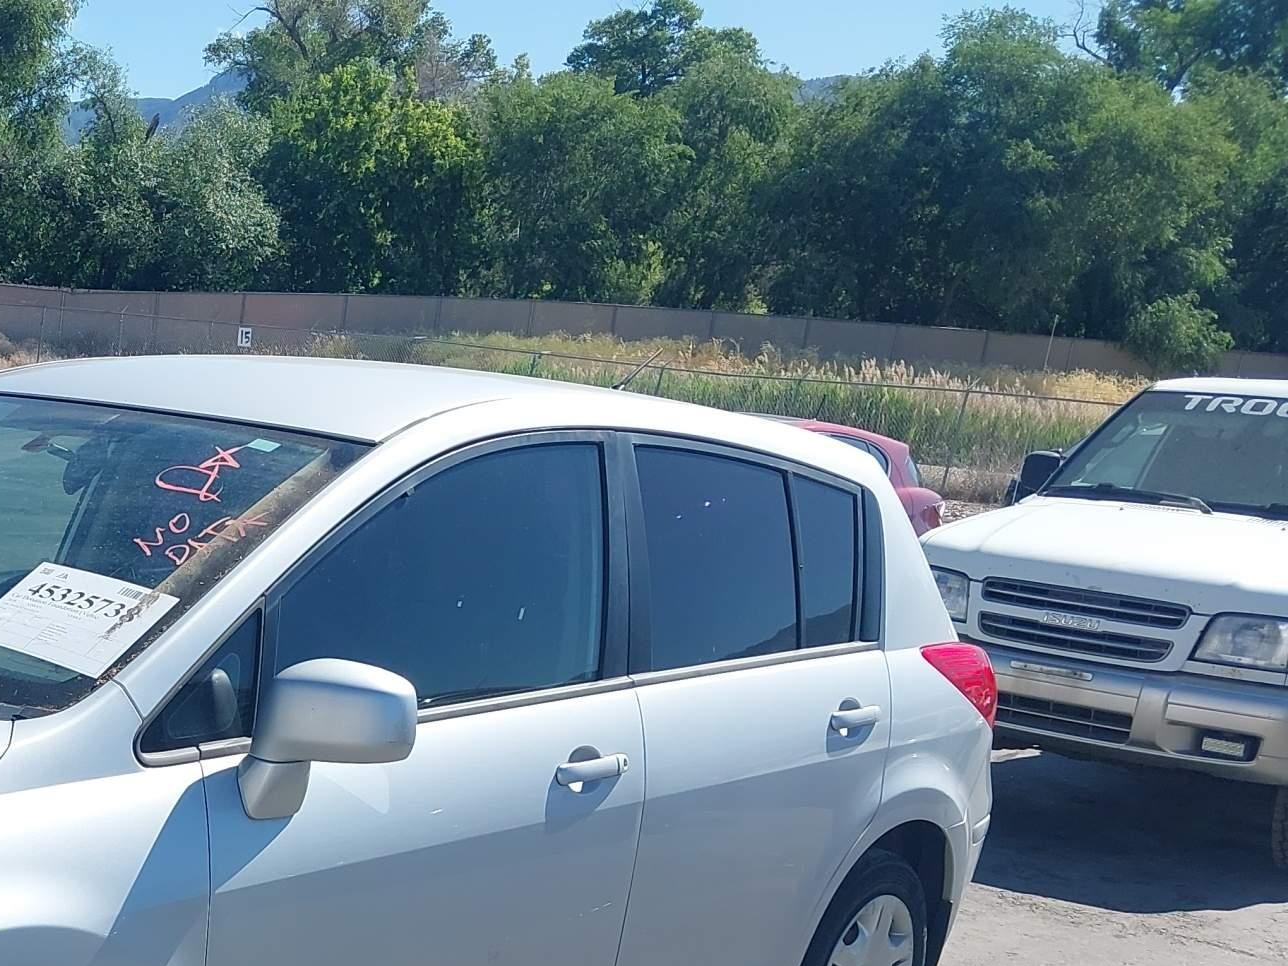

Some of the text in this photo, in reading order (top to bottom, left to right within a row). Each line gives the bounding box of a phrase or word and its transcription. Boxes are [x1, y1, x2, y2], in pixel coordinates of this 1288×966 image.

[240, 329, 251, 345] 15
[133, 512, 190, 556] NO
[28, 582, 142, 622] 45325738
[1043, 612, 1101, 631] ISUZU
